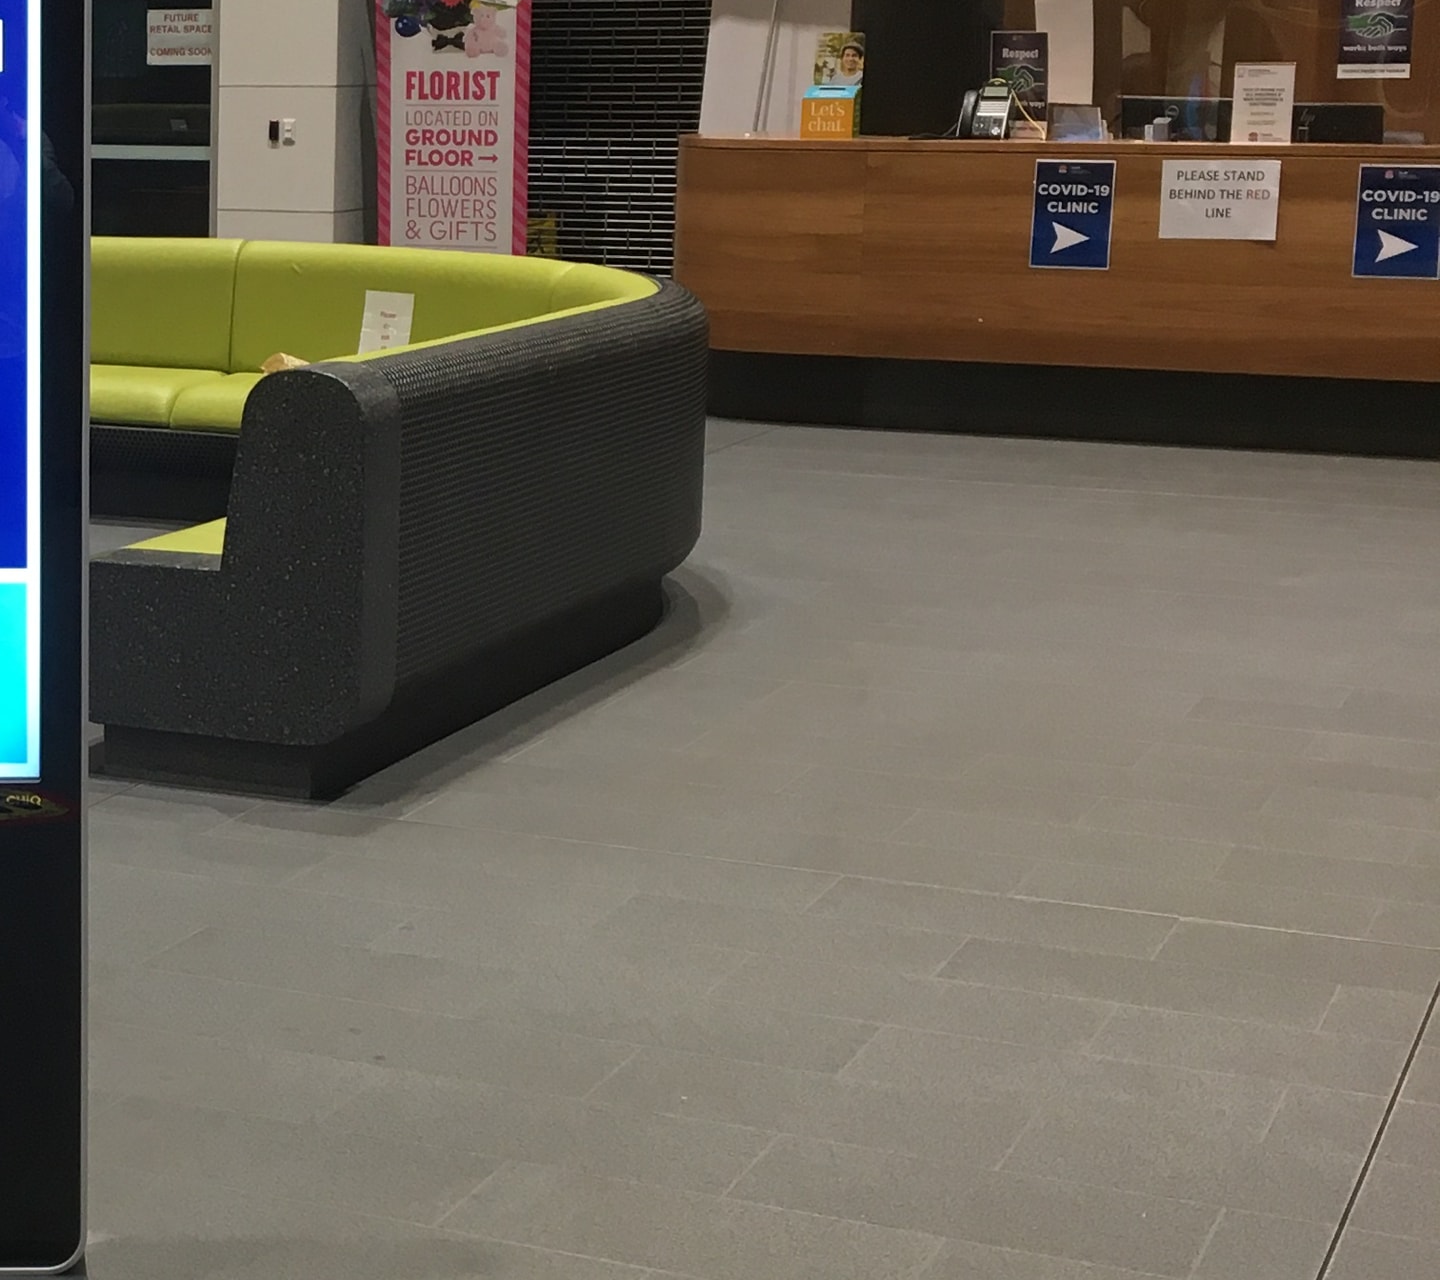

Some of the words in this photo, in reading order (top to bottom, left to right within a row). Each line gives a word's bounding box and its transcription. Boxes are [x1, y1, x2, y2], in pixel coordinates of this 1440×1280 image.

[164, 14, 199, 22] FUTURE
[150, 25, 181, 33] RETAIL
[150, 48, 185, 57] COMING
[1002, 48, 1039, 60] Respect
[406, 71, 500, 100] FLORIST
[406, 110, 471, 126] LOCATED
[479, 111, 498, 126] ON
[406, 129, 498, 146] GROUND
[406, 149, 473, 166] FLOOR
[1177, 170, 1219, 181] PLEASE
[1224, 171, 1264, 181] STAND
[406, 175, 497, 196] BALLOONS
[1038, 183, 1110, 196] COVID-19
[1169, 189, 1215, 199] BEHIND
[1219, 189, 1242, 200] THE
[1247, 190, 1270, 199] RED
[1361, 189, 1440, 203] COVID-19
[406, 198, 497, 219] FLOWERS
[1047, 201, 1098, 213] CLINIC
[1206, 208, 1231, 218] LINE
[1371, 208, 1428, 220] CLINIC
[405, 220, 421, 240] &
[429, 220, 497, 241] GIFTS
